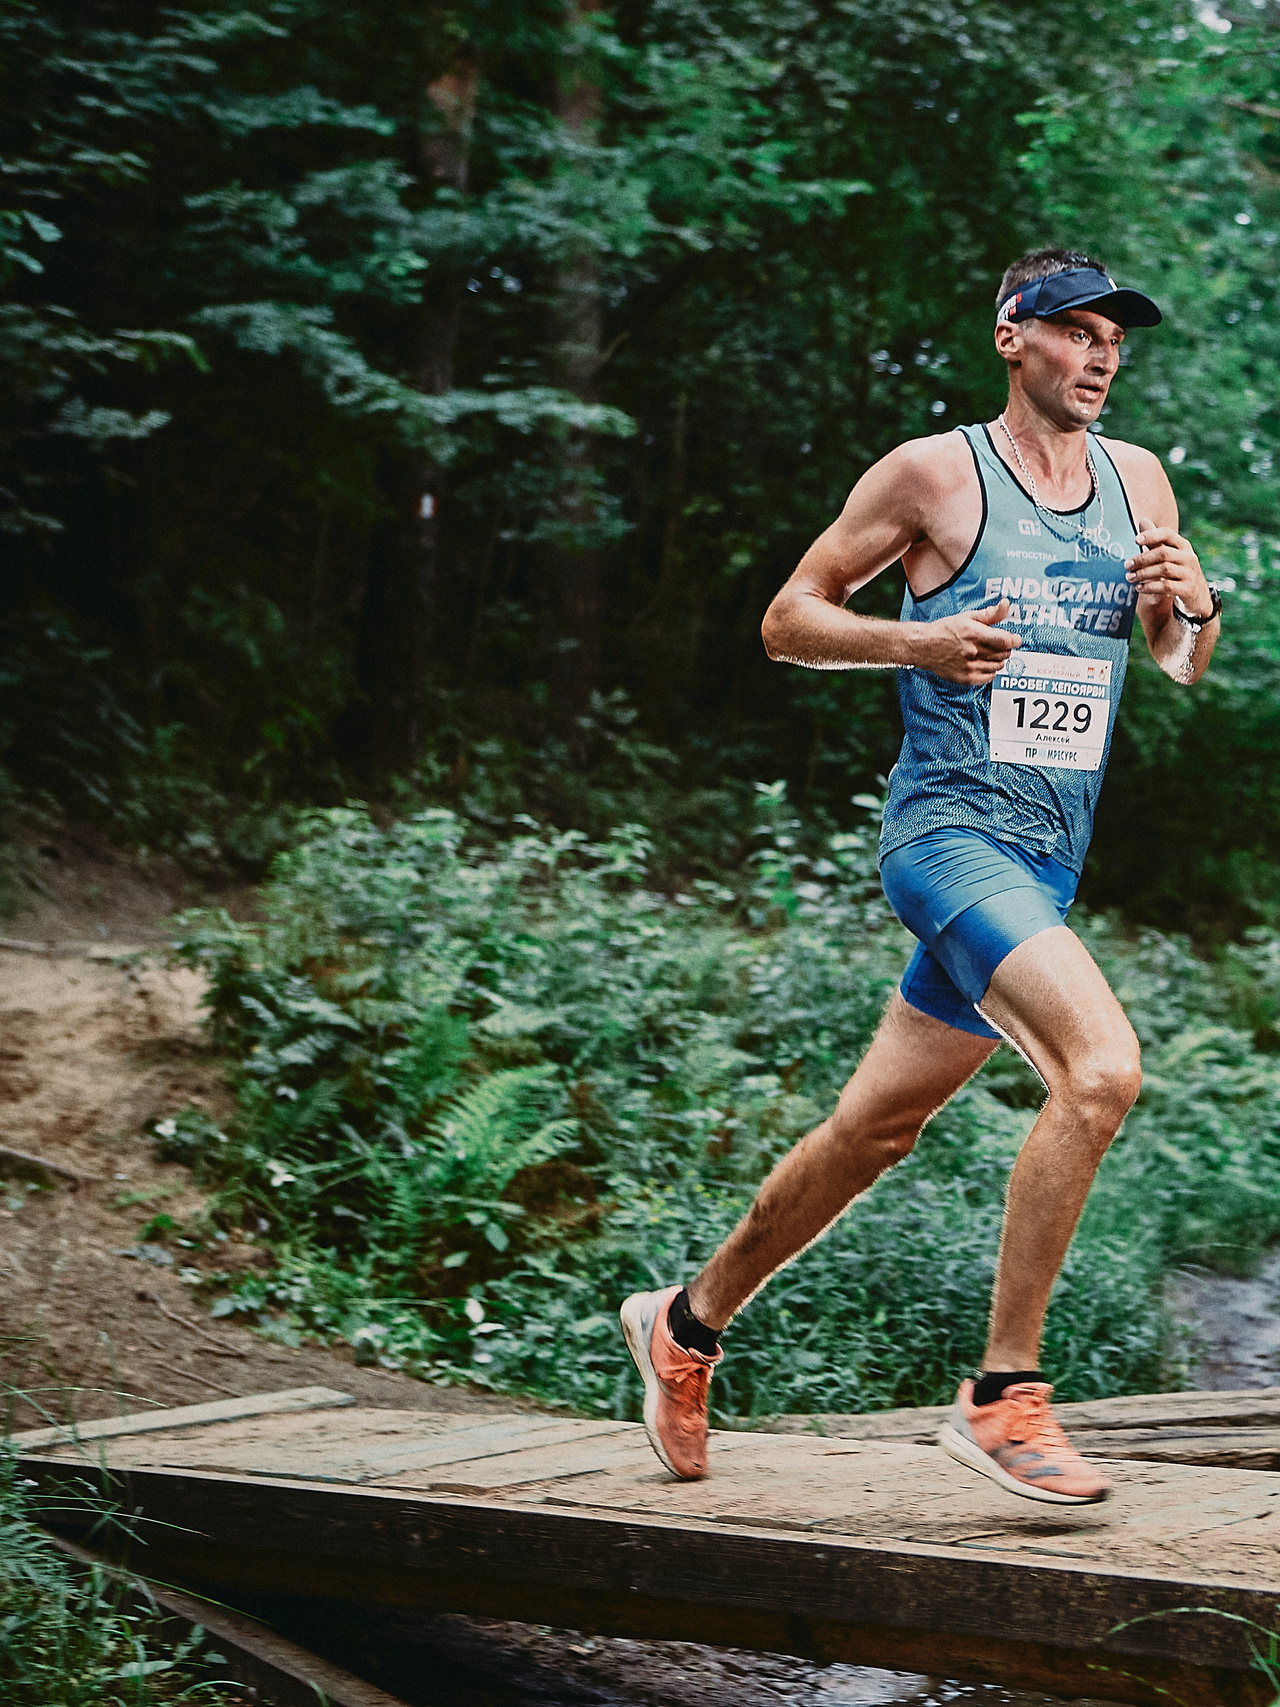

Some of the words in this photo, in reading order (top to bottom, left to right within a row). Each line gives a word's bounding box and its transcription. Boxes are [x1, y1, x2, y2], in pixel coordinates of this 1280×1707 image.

[1000, 603, 1123, 632] ATHLETES
[1000, 676, 1050, 692] ПРОБЕГ
[1051, 682, 1106, 699] ХЕПОЯРВИ
[1012, 697, 1092, 733] 1229
[1035, 733, 1072, 744] Алексей
